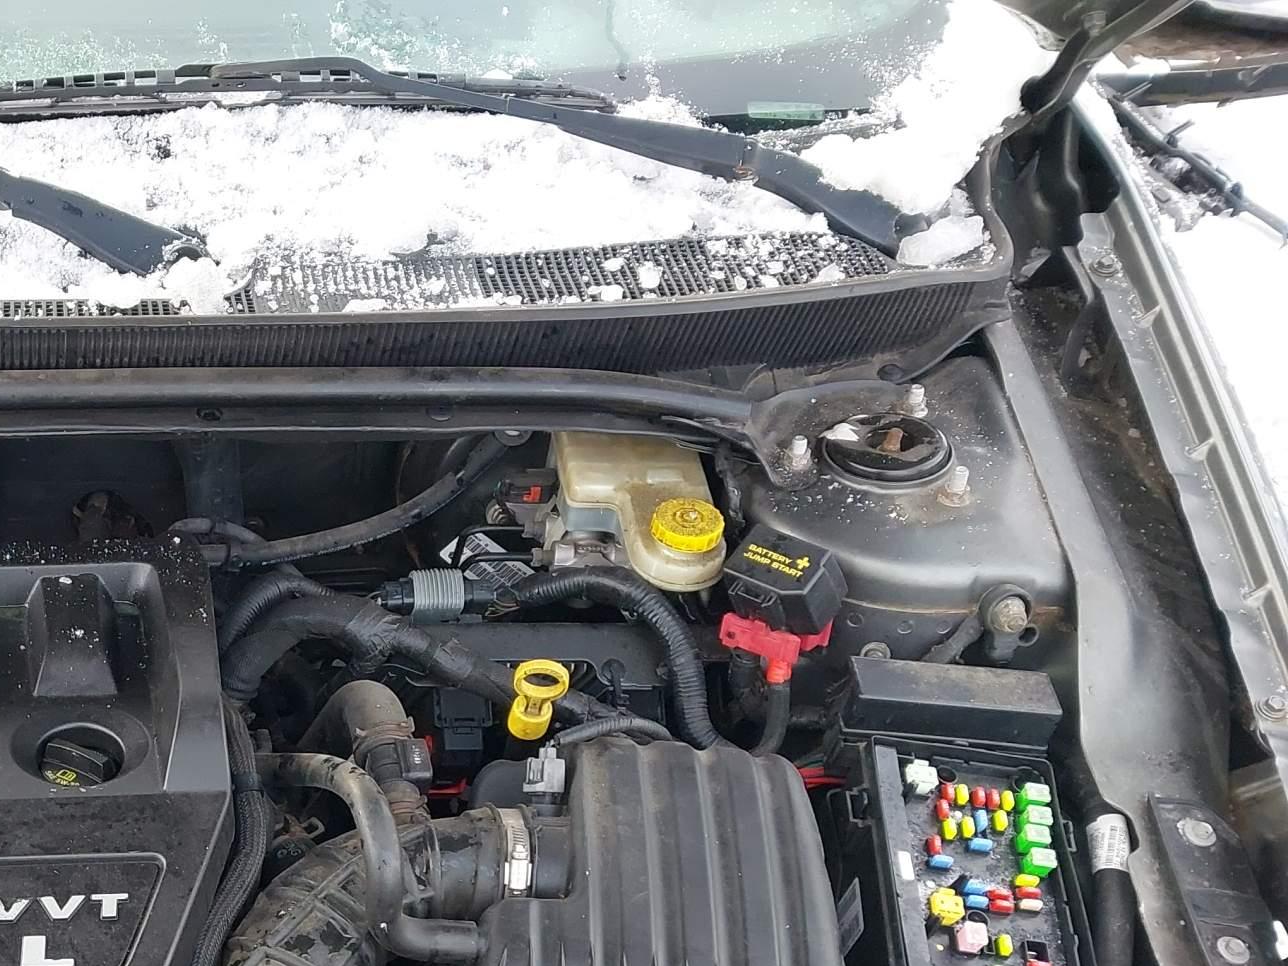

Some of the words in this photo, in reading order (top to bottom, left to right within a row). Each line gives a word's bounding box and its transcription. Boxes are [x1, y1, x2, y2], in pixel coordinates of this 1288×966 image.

[743, 551, 772, 564] JUMP
[771, 561, 804, 577] START
[748, 543, 793, 564] BATTERY
